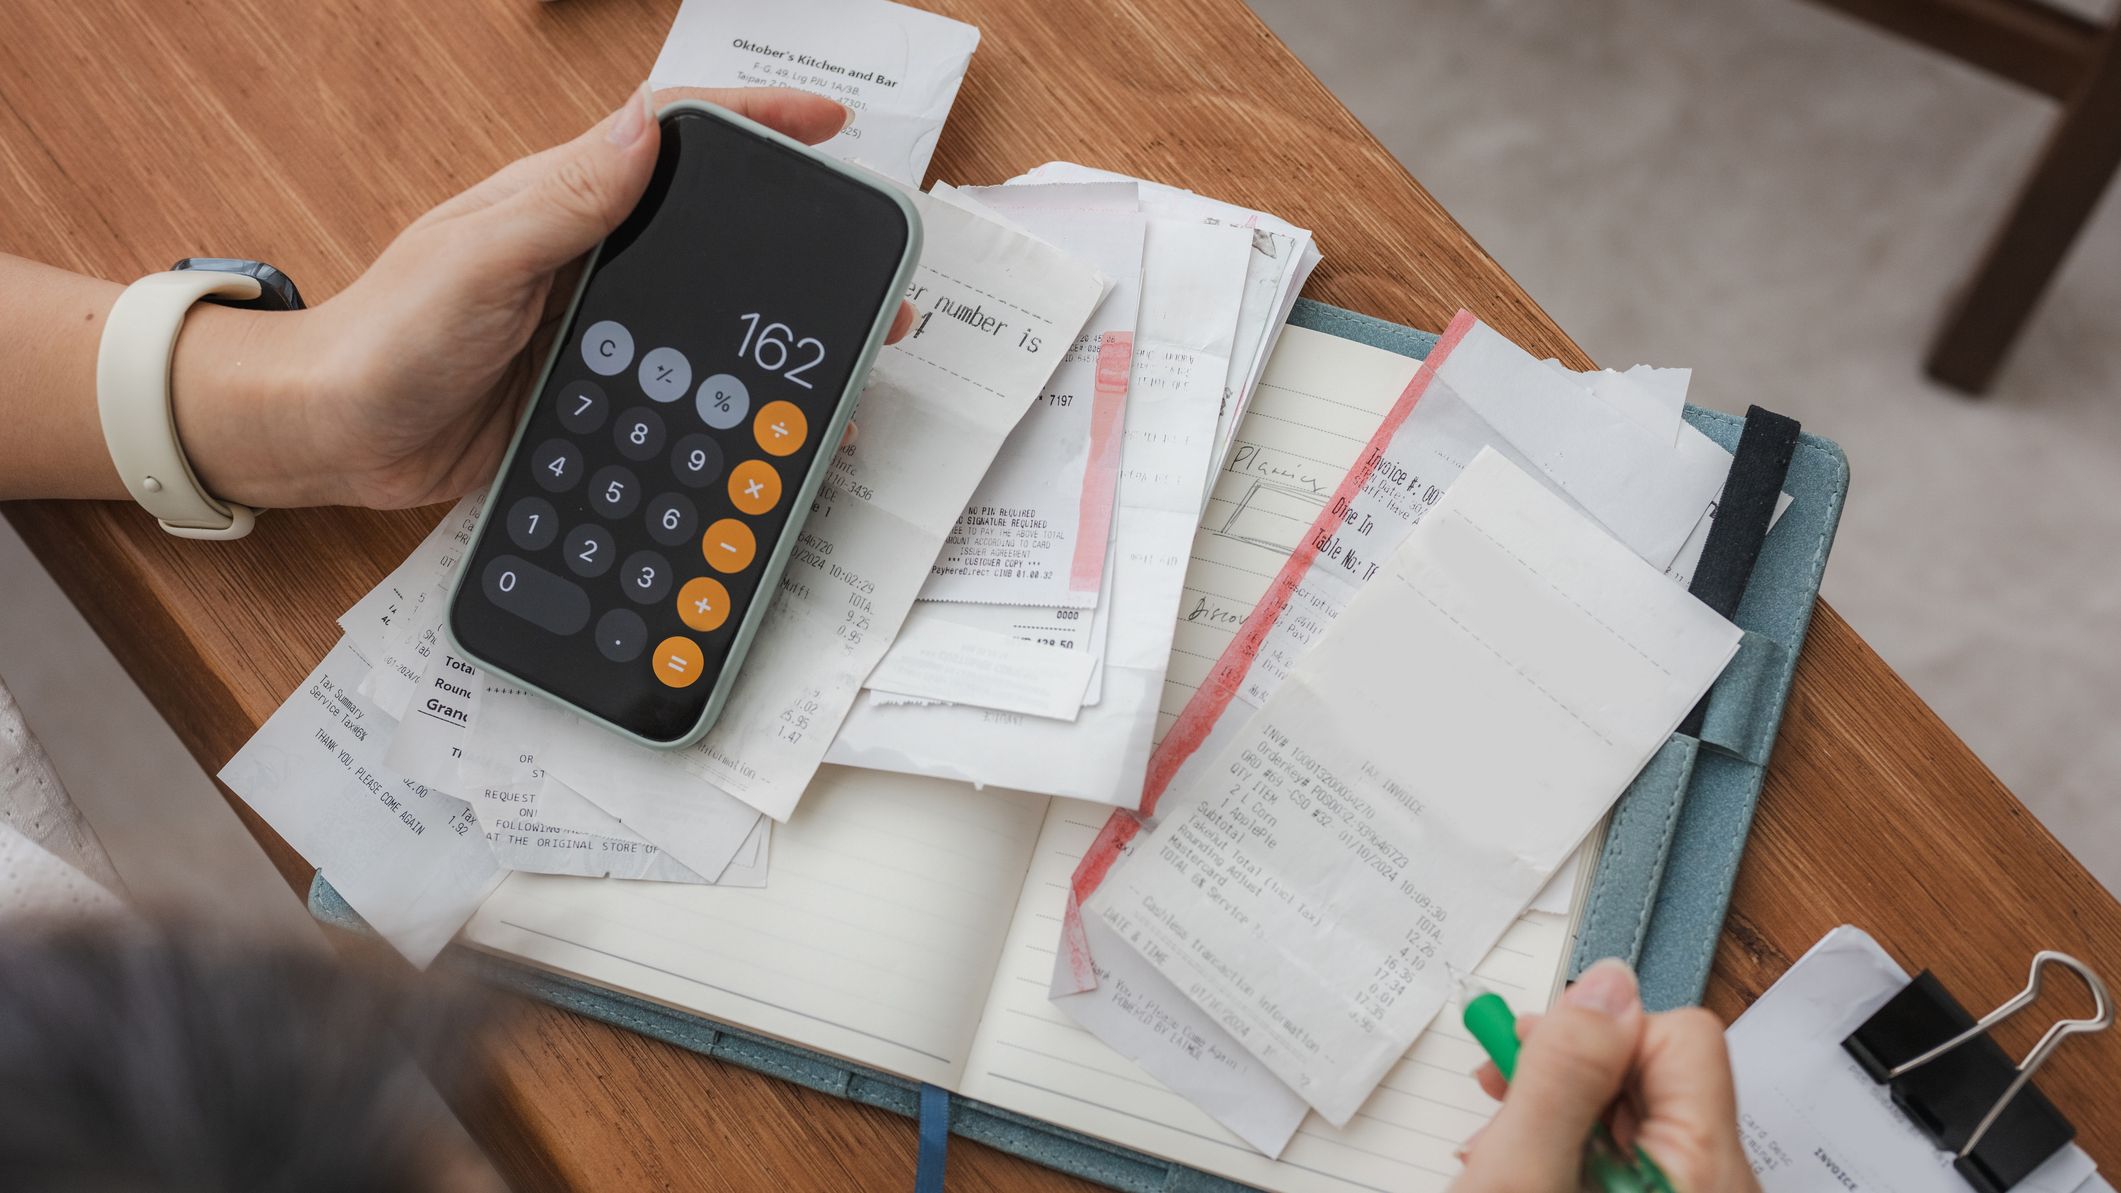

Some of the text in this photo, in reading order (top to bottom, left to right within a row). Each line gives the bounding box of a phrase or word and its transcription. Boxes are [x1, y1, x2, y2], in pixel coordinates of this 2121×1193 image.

[733, 38, 898, 89] Oktober's Kitchen and Bar
[737, 71, 767, 87] Taipan
[810, 75, 828, 88] PJU
[934, 296, 1008, 336] number
[1018, 328, 1043, 354] is
[737, 312, 825, 389] 162
[599, 339, 731, 413] C %
[1049, 394, 1074, 407] 7197
[573, 394, 706, 472] 7 8 9
[1366, 447, 1408, 486] Invoice
[547, 456, 682, 530] 4 5 6
[1354, 474, 1382, 503] Staff:
[1377, 480, 1406, 500] Date:
[1000, 507, 1036, 519] REQUIRED
[1011, 518, 1047, 529] REQUIRED
[1332, 496, 1373, 537] Dine In
[526, 513, 540, 534] 1
[578, 540, 598, 563] 2
[636, 566, 656, 588] 3
[974, 537, 1015, 548] ACCORDING
[1034, 539, 1051, 550] CARD
[980, 527, 994, 537] PAY
[1016, 529, 1039, 539] ABOVE
[1312, 528, 1342, 560] Table
[1342, 549, 1361, 573] No:
[960, 547, 1031, 559] ISSUER AGREEMENT
[964, 557, 1024, 568] CUSTOMER COPY
[498, 571, 517, 593] 0
[829, 564, 876, 595] 10:02:29
[837, 625, 862, 645] 0.95
[847, 610, 870, 631] 9.25
[309, 685, 339, 718] Service
[319, 674, 366, 720] Tax Summary
[777, 724, 803, 745] 1.47
[1263, 723, 1289, 748] INV#
[519, 754, 534, 765] OR
[1257, 740, 1310, 787] OrderKey#
[315, 728, 426, 837] THANK YOU, PLEASE COME AGAIN
[484, 789, 536, 804] REQUEST
[1229, 762, 1252, 784] QTY
[1252, 780, 1278, 806] ITEM
[1382, 779, 1426, 817] INVOICE
[461, 807, 477, 826] Tax
[1197, 800, 1247, 845] Subtotal
[1230, 784, 1241, 796] 2
[1252, 801, 1278, 828] Corn
[448, 815, 469, 837] 1.92
[486, 832, 500, 843] AT
[509, 834, 529, 847] THE
[537, 837, 594, 851] ORIGINAL
[602, 841, 637, 854] STORE
[1240, 749, 1262, 771] ORD
[1263, 768, 1285, 788] #69
[1338, 830, 1397, 883] 01/10/2024
[1399, 879, 1448, 923] 10:09:30
[1168, 833, 1229, 887] Mastercard
[1159, 845, 1188, 875] TOTAL
[1206, 886, 1250, 926] Service
[1220, 797, 1426, 971] 1 ApplePie 4.10
[1178, 823, 1396, 1008] Rounding Adjust 0.01
[1189, 814, 1230, 851] TakeOut
[1231, 849, 1263, 877] Total
[1374, 967, 1406, 996] 17.34
[1191, 938, 1256, 998] transaction
[1258, 994, 1321, 1054] information
[1742, 1113, 1795, 1167] Card Desc
[1813, 1147, 1860, 1193] INVOICE
